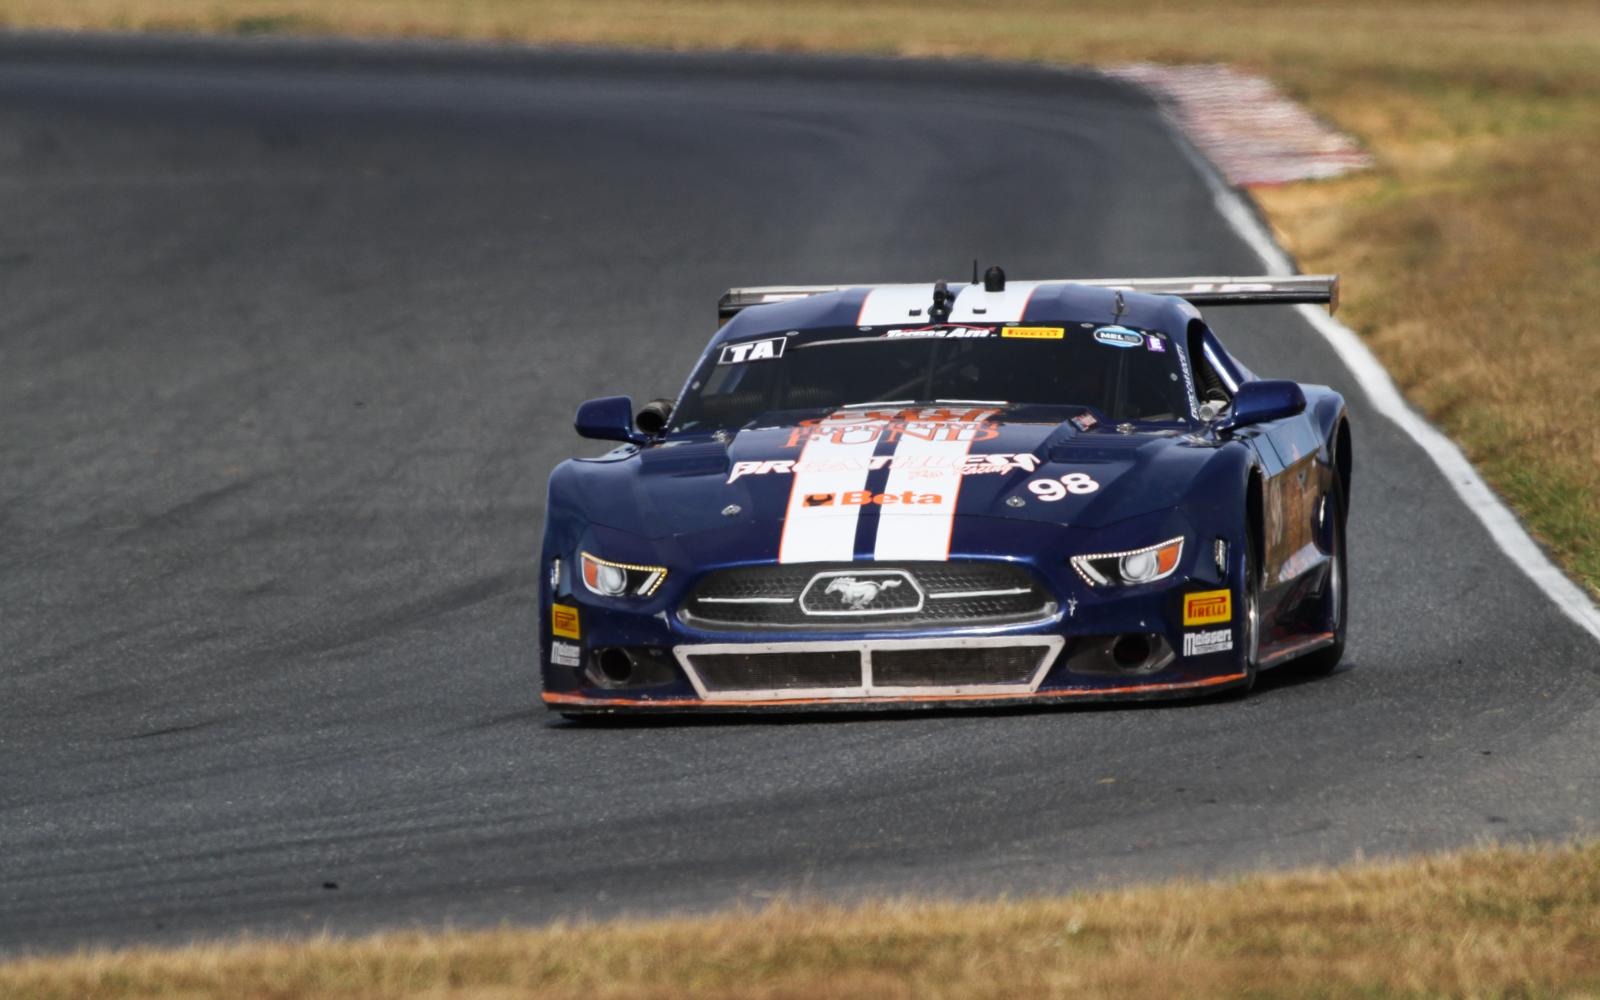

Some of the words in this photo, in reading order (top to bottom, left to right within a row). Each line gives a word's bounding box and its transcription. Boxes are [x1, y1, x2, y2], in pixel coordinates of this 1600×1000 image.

[730, 341, 773, 362] TA
[840, 489, 943, 505] Beta
[1028, 473, 1099, 501] 98
[1188, 596, 1227, 618] PIRELLI
